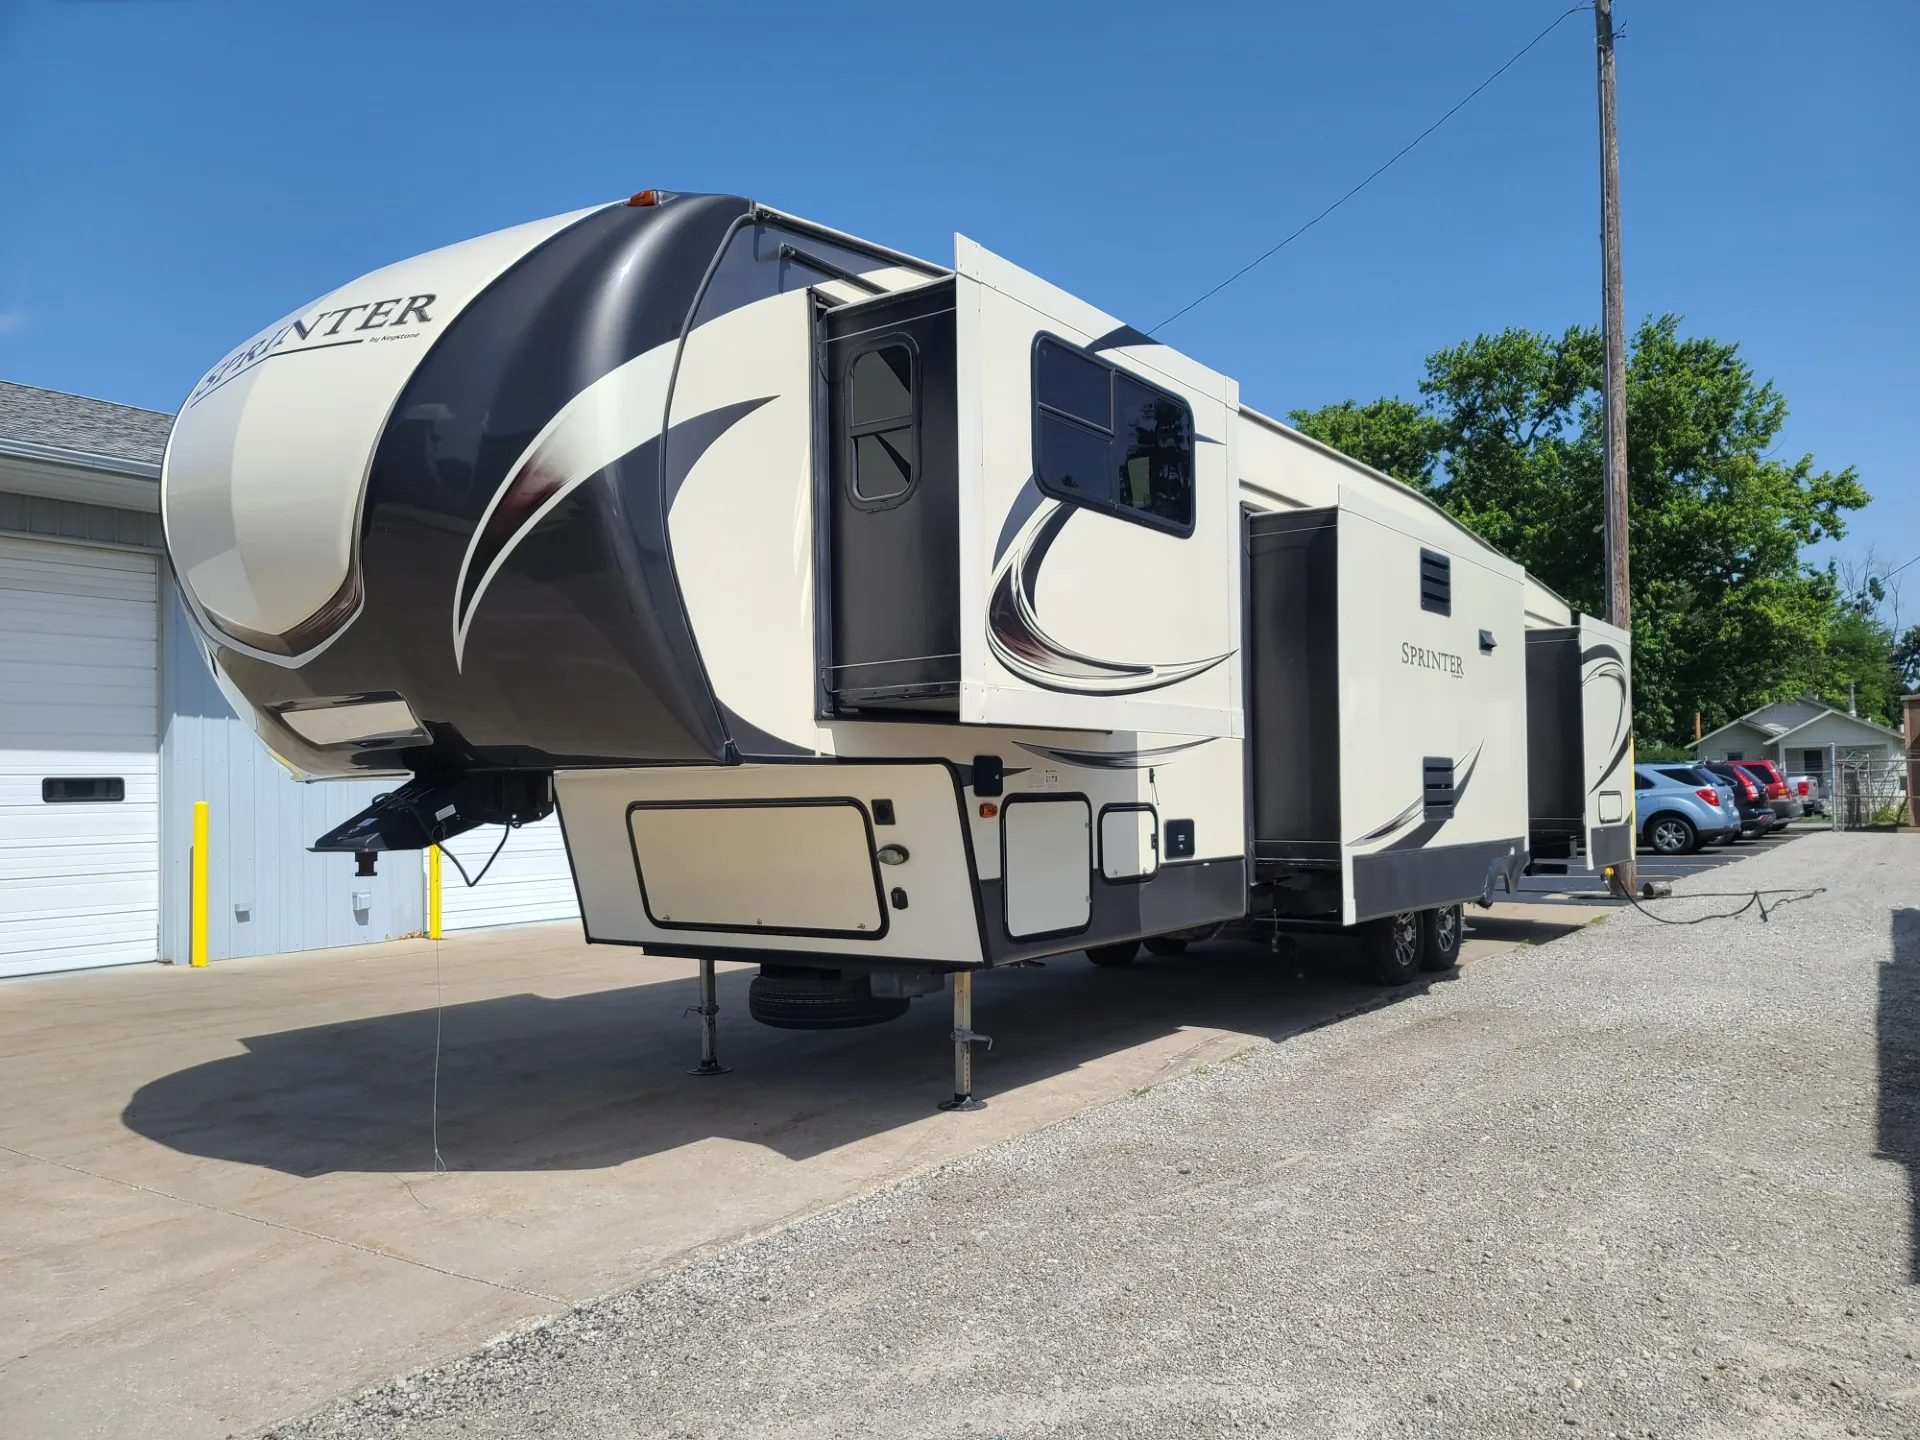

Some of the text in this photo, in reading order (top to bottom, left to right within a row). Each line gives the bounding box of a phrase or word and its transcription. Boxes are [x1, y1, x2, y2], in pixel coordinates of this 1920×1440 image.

[193, 293, 437, 398] SPRINTER
[381, 332, 420, 342] Keystone
[1401, 642, 1464, 675] SPRINTER
